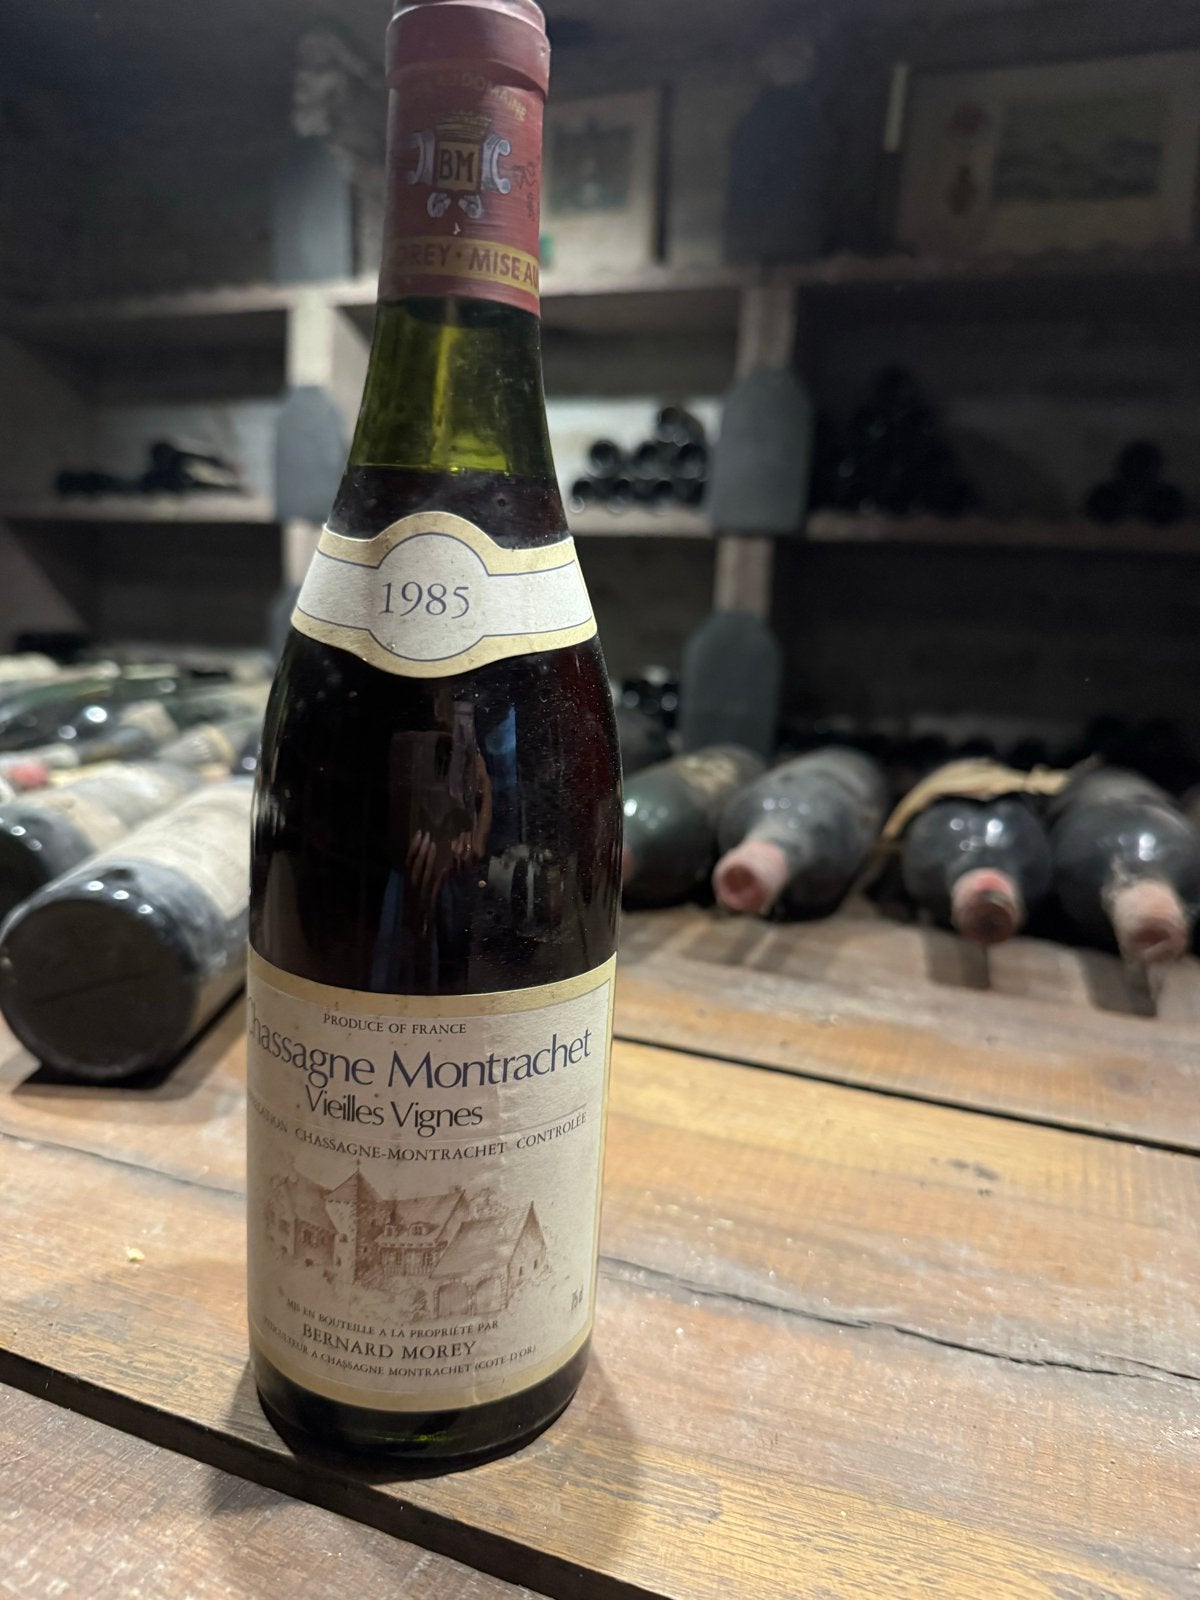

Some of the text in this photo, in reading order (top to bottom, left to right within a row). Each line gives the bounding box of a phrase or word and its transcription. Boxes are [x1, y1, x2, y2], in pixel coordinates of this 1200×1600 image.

[439, 148, 475, 183] BM
[468, 246, 520, 281] MISE
[378, 580, 470, 619] 1985
[323, 1013, 467, 1036] PRODUCE OF FRANCE
[388, 1027, 592, 1089] Montrachet
[305, 1084, 483, 1138] Vieilles Vignes
[295, 1127, 507, 1162] CHASSAGNE-MONTRACHET
[302, 1306, 315, 1320] EN
[318, 1313, 376, 1335] BOUTEILLE
[390, 1327, 405, 1338] LA
[478, 1319, 499, 1333] PAR
[302, 1323, 478, 1361] BERNARD MOREY
[320, 1353, 385, 1376] CHASSAGNE
[388, 1363, 473, 1377] MONTRACHET
